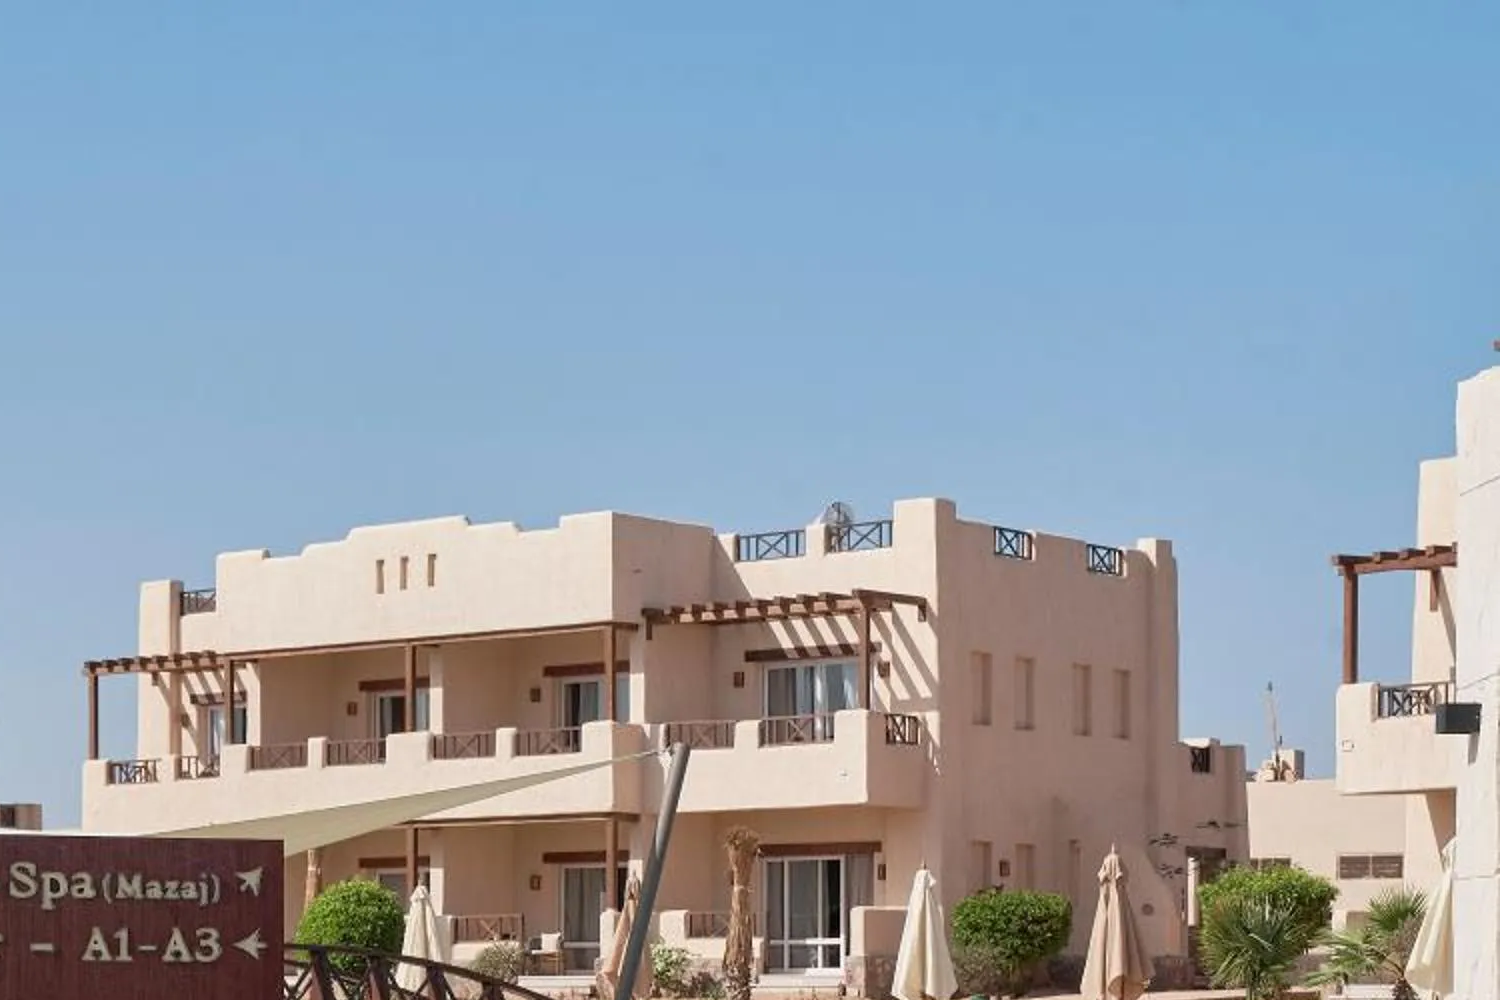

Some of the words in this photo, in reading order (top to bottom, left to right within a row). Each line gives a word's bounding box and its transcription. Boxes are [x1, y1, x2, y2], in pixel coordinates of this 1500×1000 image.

[8, 861, 97, 910] Spa
[102, 873, 221, 905] (Mazaj)
[82, 926, 222, 963] A1-A3
